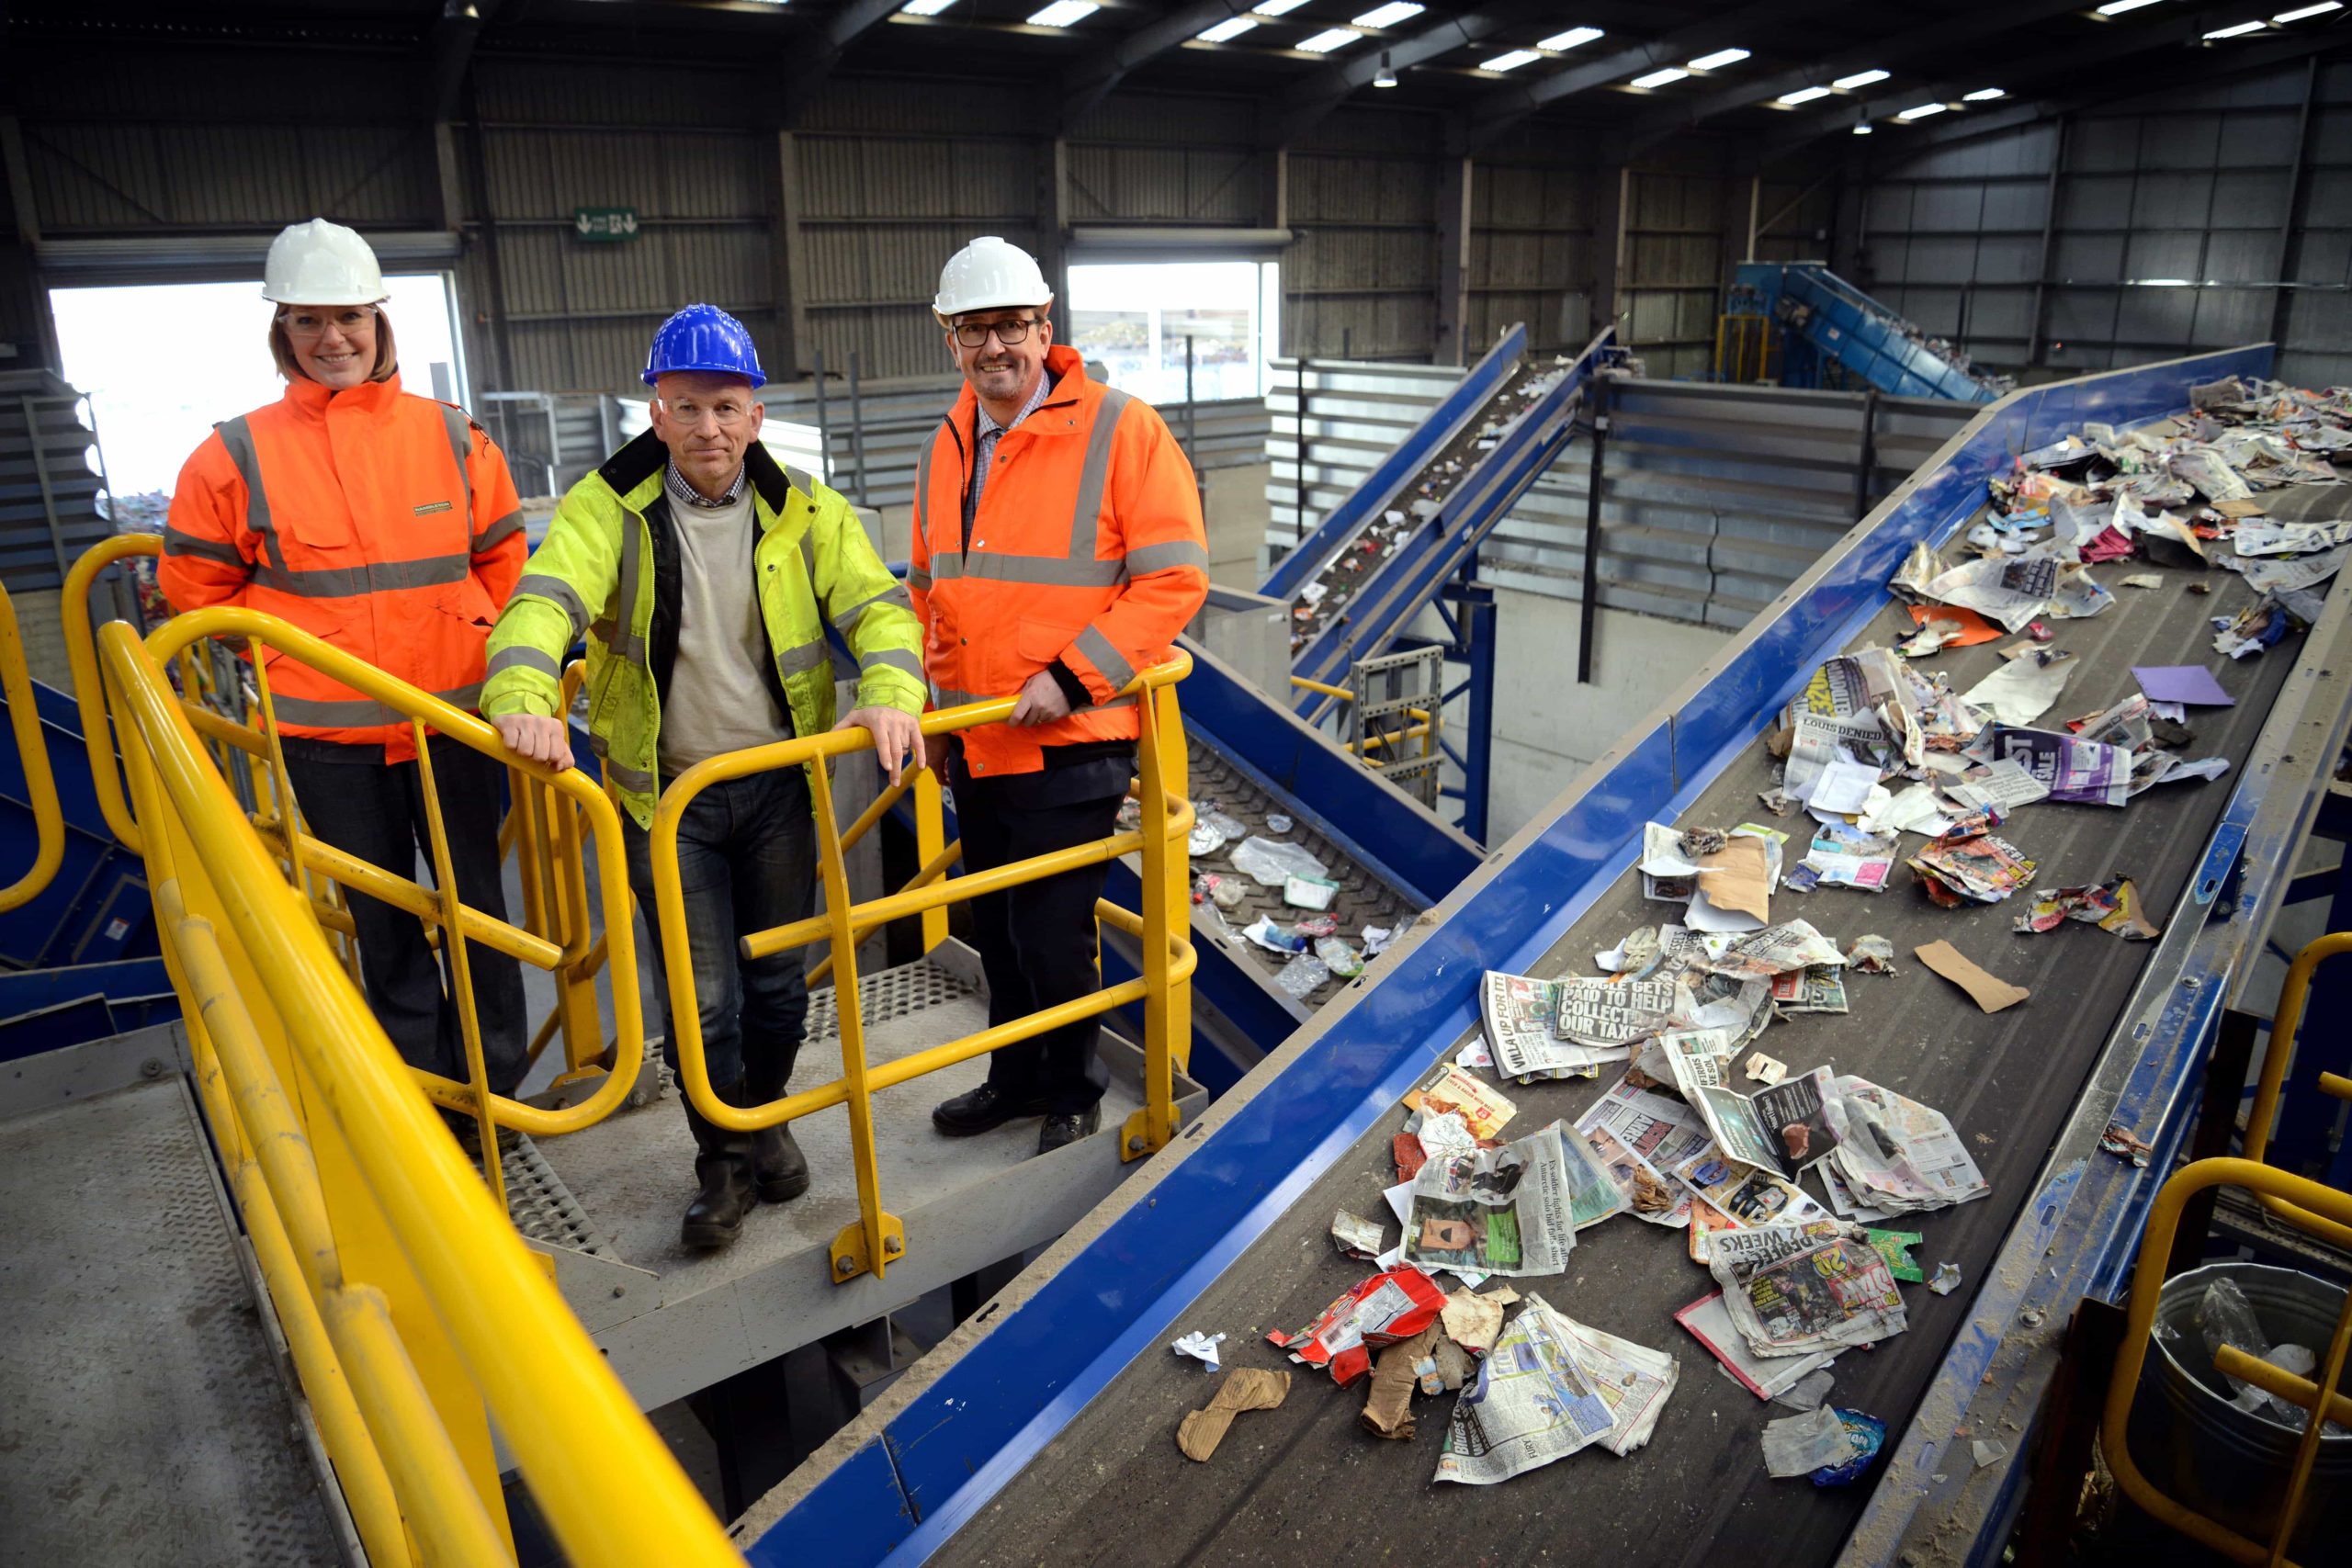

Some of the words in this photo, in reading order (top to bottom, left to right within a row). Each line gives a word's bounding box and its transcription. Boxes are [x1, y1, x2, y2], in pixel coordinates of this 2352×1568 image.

[1803, 718, 1838, 733] LOUIS
[1838, 725, 1882, 741] DENIED
[1562, 989, 1600, 1002] PAID
[1607, 990, 1627, 1006] TO
[1630, 993, 1673, 1012] HELP
[1632, 982, 1673, 997] GETS
[1496, 993, 1509, 1017] FOR
[1561, 1000, 1632, 1023] COLLECT
[1500, 1018, 1514, 1036] UP
[1559, 1015, 1595, 1034] OUR
[1599, 1021, 1645, 1041] TAXE
[1507, 1035, 1525, 1068] VILLA
[1767, 1112, 1779, 1130] Heart
[1540, 1162, 1549, 1195] Antarctic
[1549, 1160, 1558, 1196] Ex-soldier
[1553, 1197, 1562, 1220] fights
[1720, 1230, 1781, 1253] WEEKS
[1750, 1236, 1815, 1266] PERFEC
[1454, 1419, 1469, 1455] Blues
[1522, 1438, 1539, 1459] FURY
